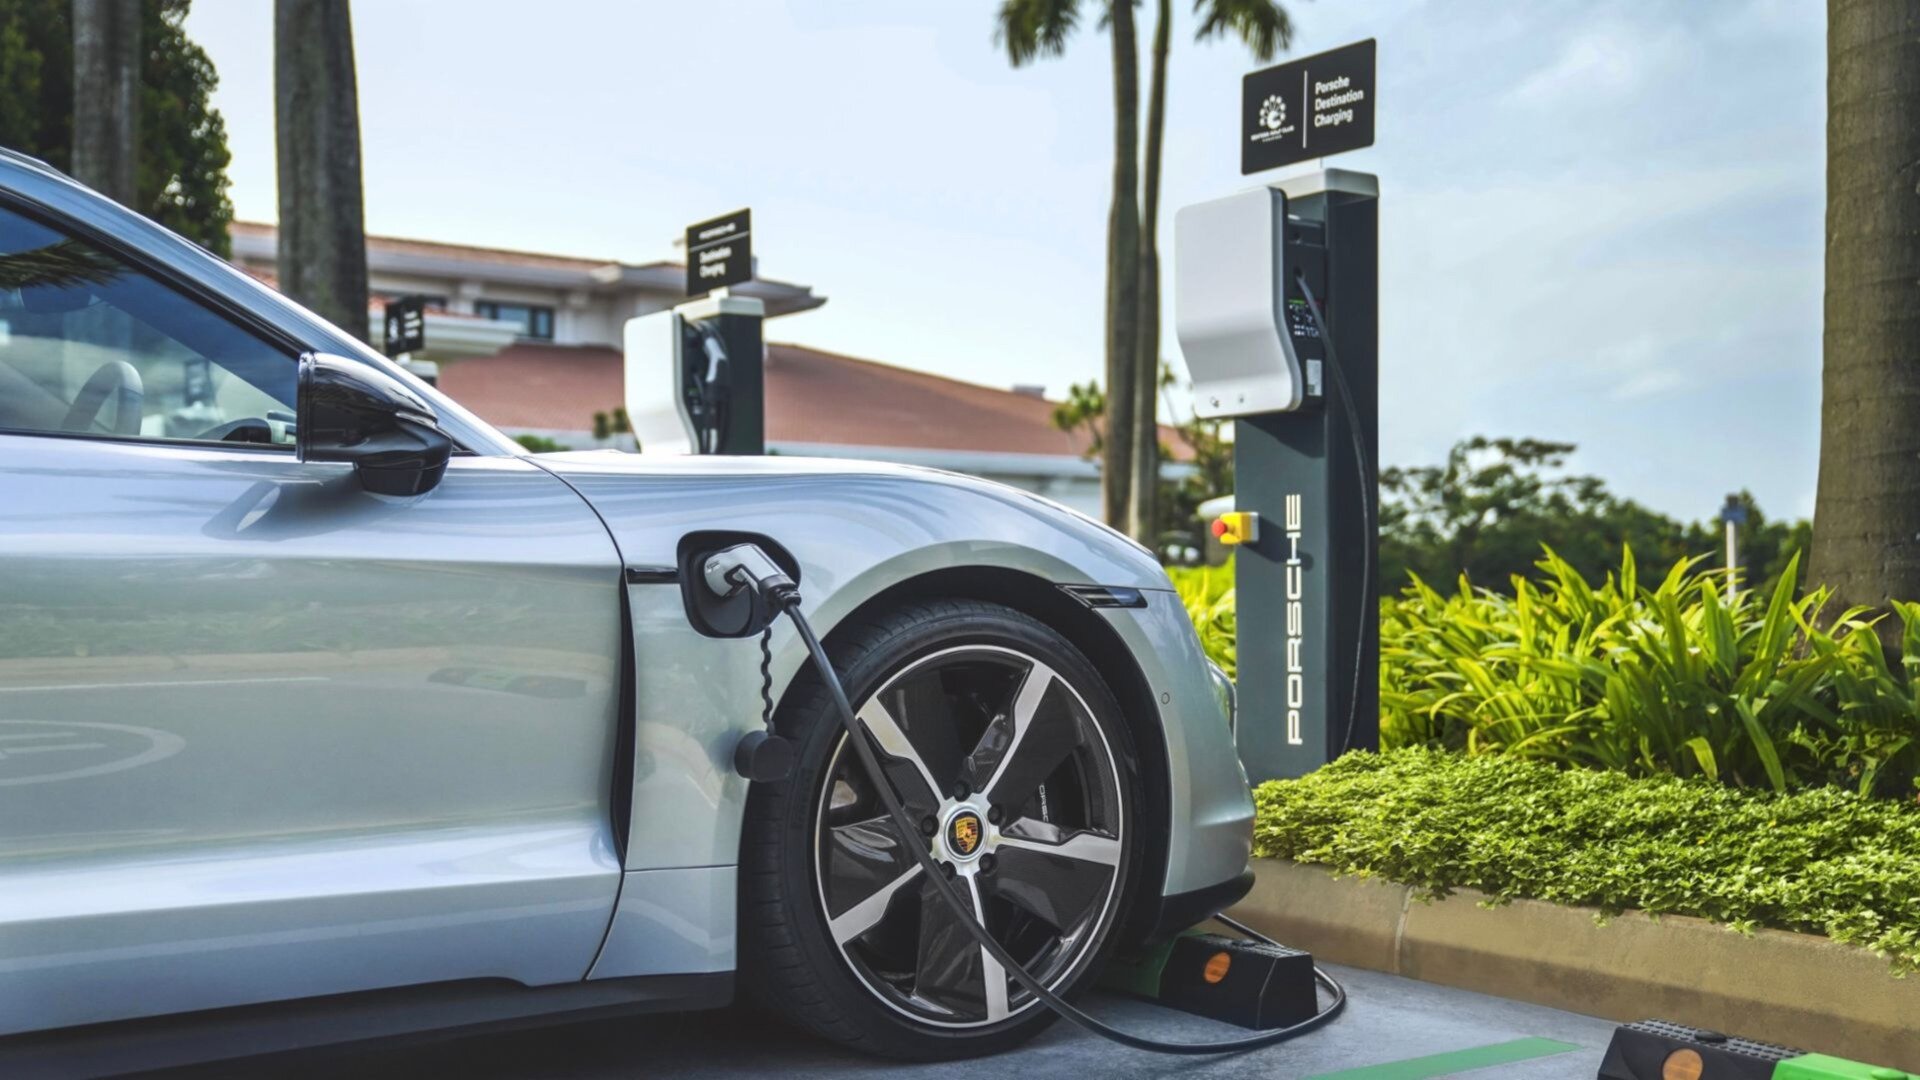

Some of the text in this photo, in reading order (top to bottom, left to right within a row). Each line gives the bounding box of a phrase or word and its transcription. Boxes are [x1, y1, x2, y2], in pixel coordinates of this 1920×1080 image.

[1315, 76, 1350, 95] Porsche
[1315, 89, 1364, 111] Destination
[1314, 109, 1353, 127] Charging
[1286, 494, 1302, 745] PORSCHE
[1039, 784, 1049, 823] ORSC
